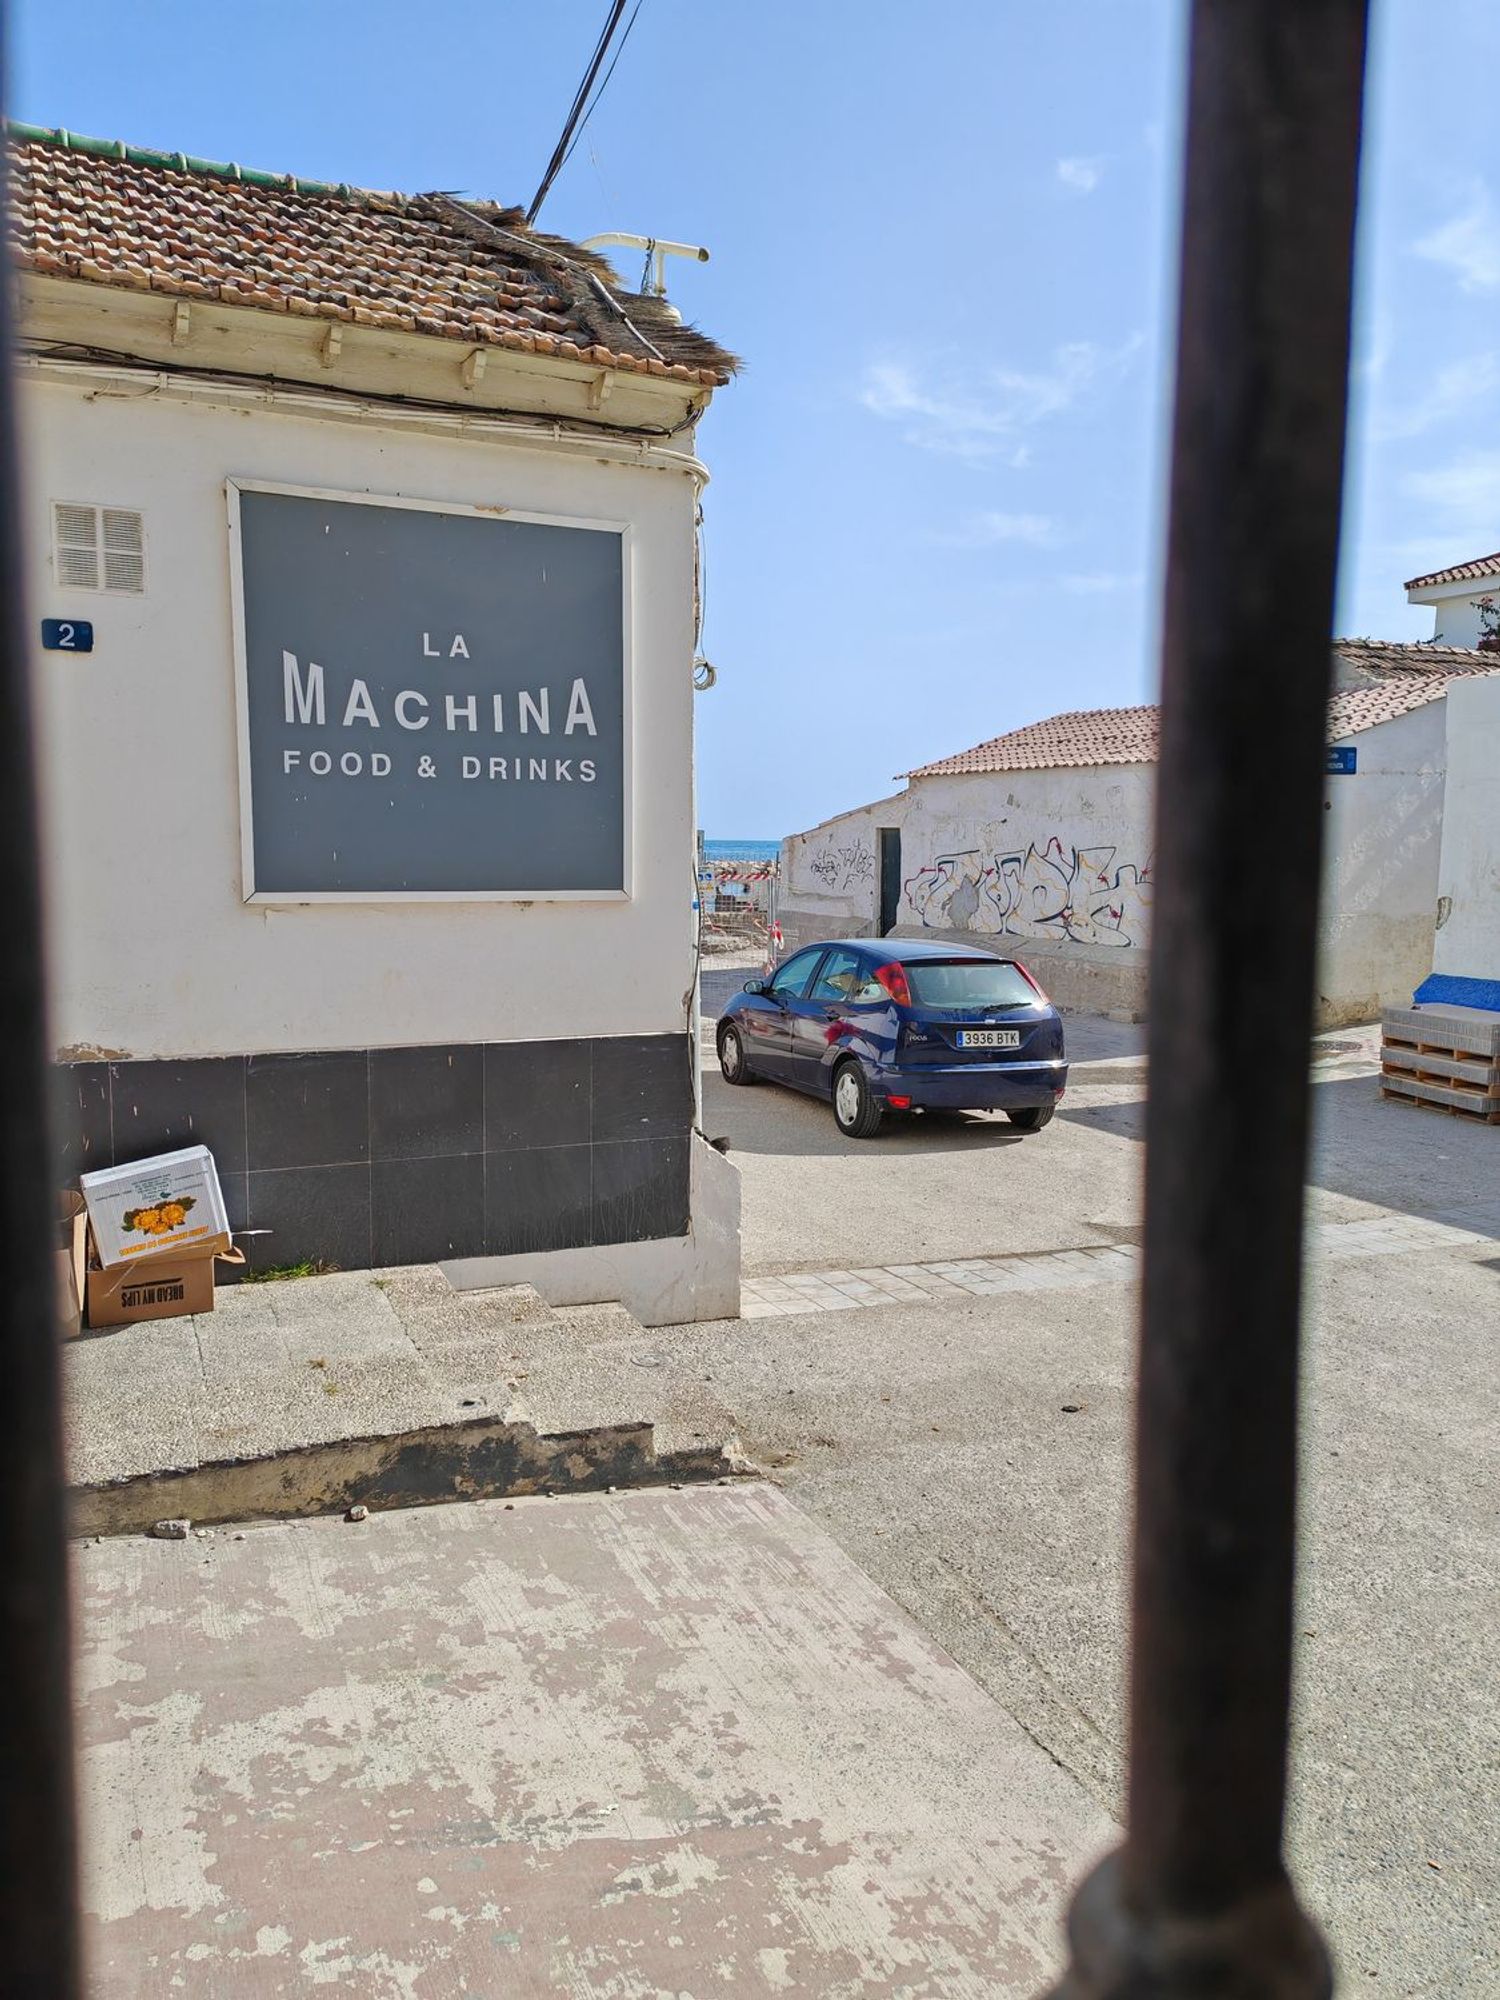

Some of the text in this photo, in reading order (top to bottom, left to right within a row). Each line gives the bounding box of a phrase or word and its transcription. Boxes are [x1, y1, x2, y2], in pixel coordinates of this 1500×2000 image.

[58, 623, 76, 648] 2
[423, 632, 471, 659] LA
[282, 650, 598, 736] MACHINA
[284, 750, 597, 783] FOOD & DRINKS
[965, 1032, 1017, 1044] 3936 BTK
[121, 1291, 140, 1308] LIPS
[142, 1288, 156, 1305] MY
